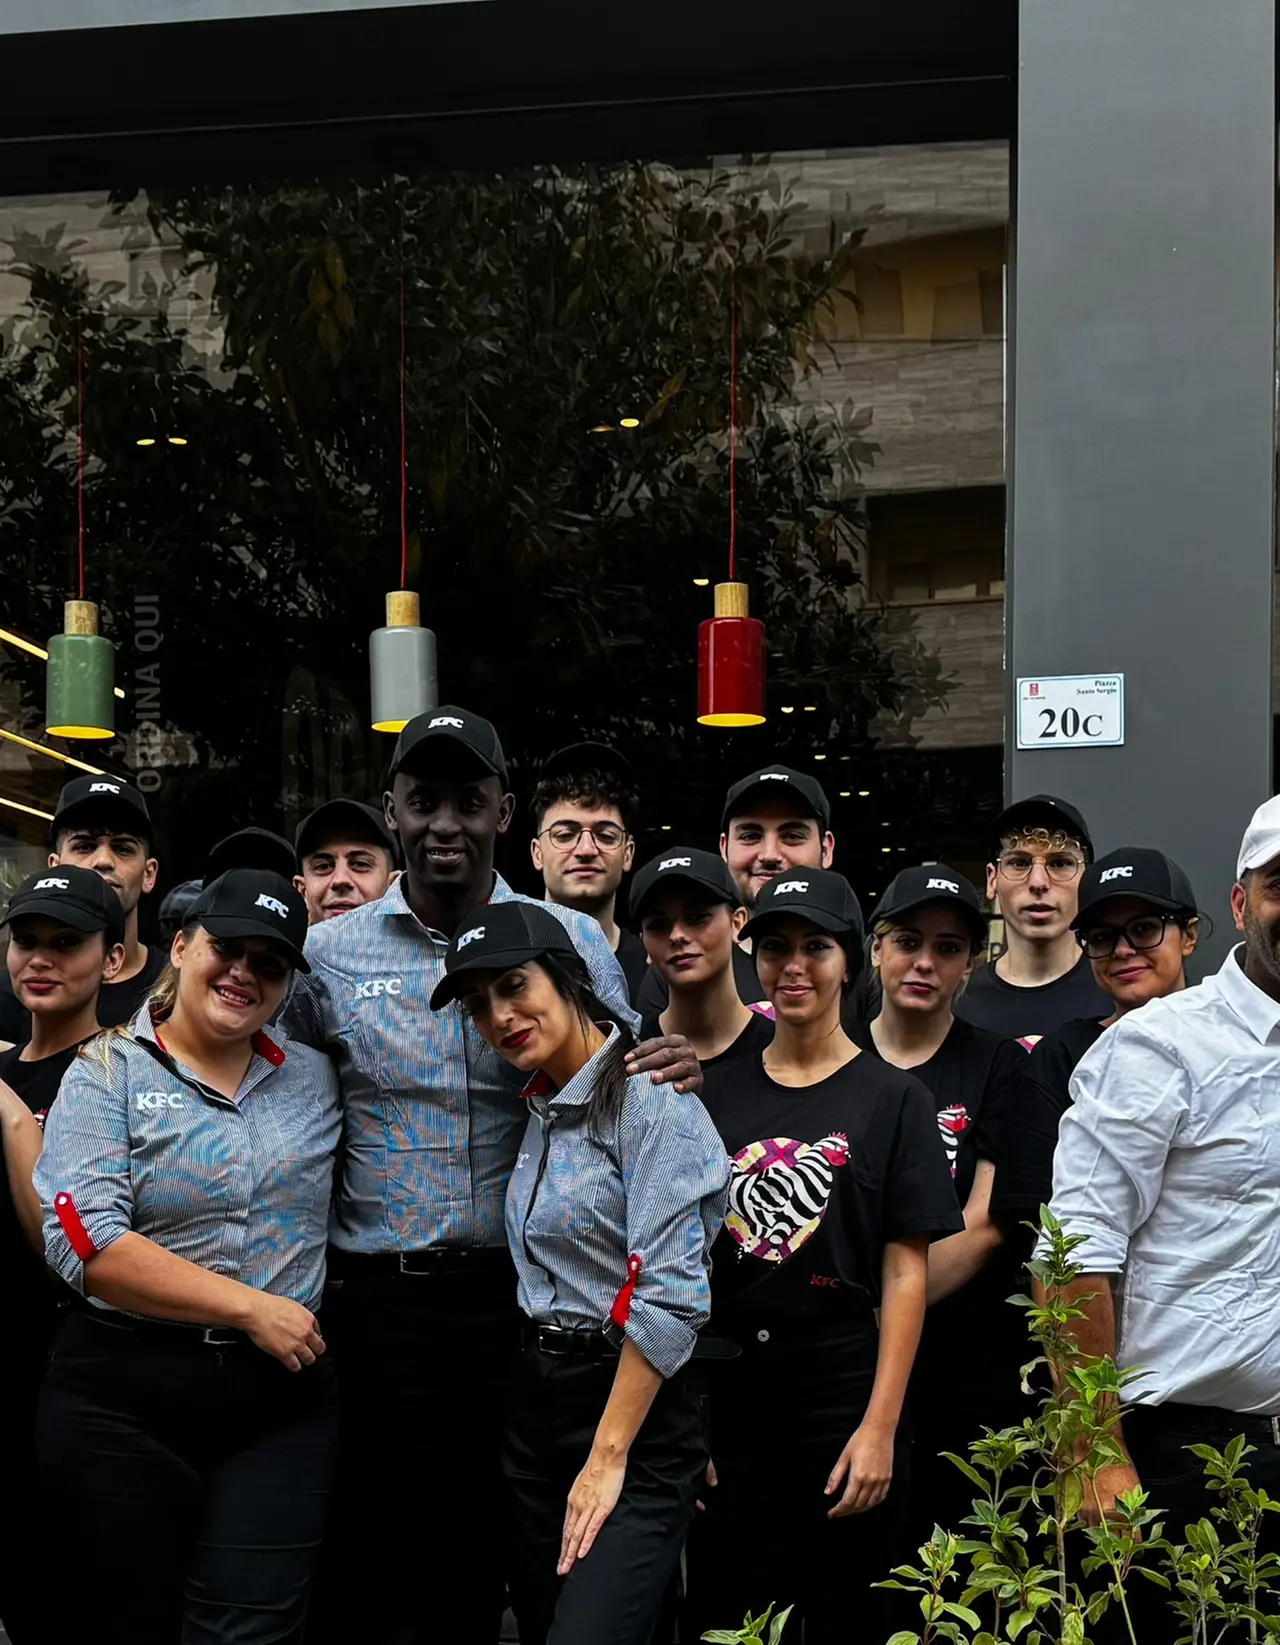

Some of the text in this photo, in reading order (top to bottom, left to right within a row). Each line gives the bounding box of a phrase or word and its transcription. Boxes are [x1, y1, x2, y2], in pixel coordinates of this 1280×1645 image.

[134, 594, 165, 793] ORDINA QUI
[428, 716, 464, 729] KFC
[1038, 707, 1103, 739] 20C
[89, 782, 121, 794] KFC
[658, 857, 691, 871] KFC
[33, 877, 69, 890] KFC
[1099, 866, 1133, 884] KFC
[773, 880, 809, 896] KFC
[926, 878, 959, 894] KFC
[254, 893, 289, 918] KFC
[457, 926, 486, 952] KFC
[354, 978, 401, 1000] KFC
[136, 1092, 184, 1110] KFC
[810, 1273, 840, 1289] KFC
